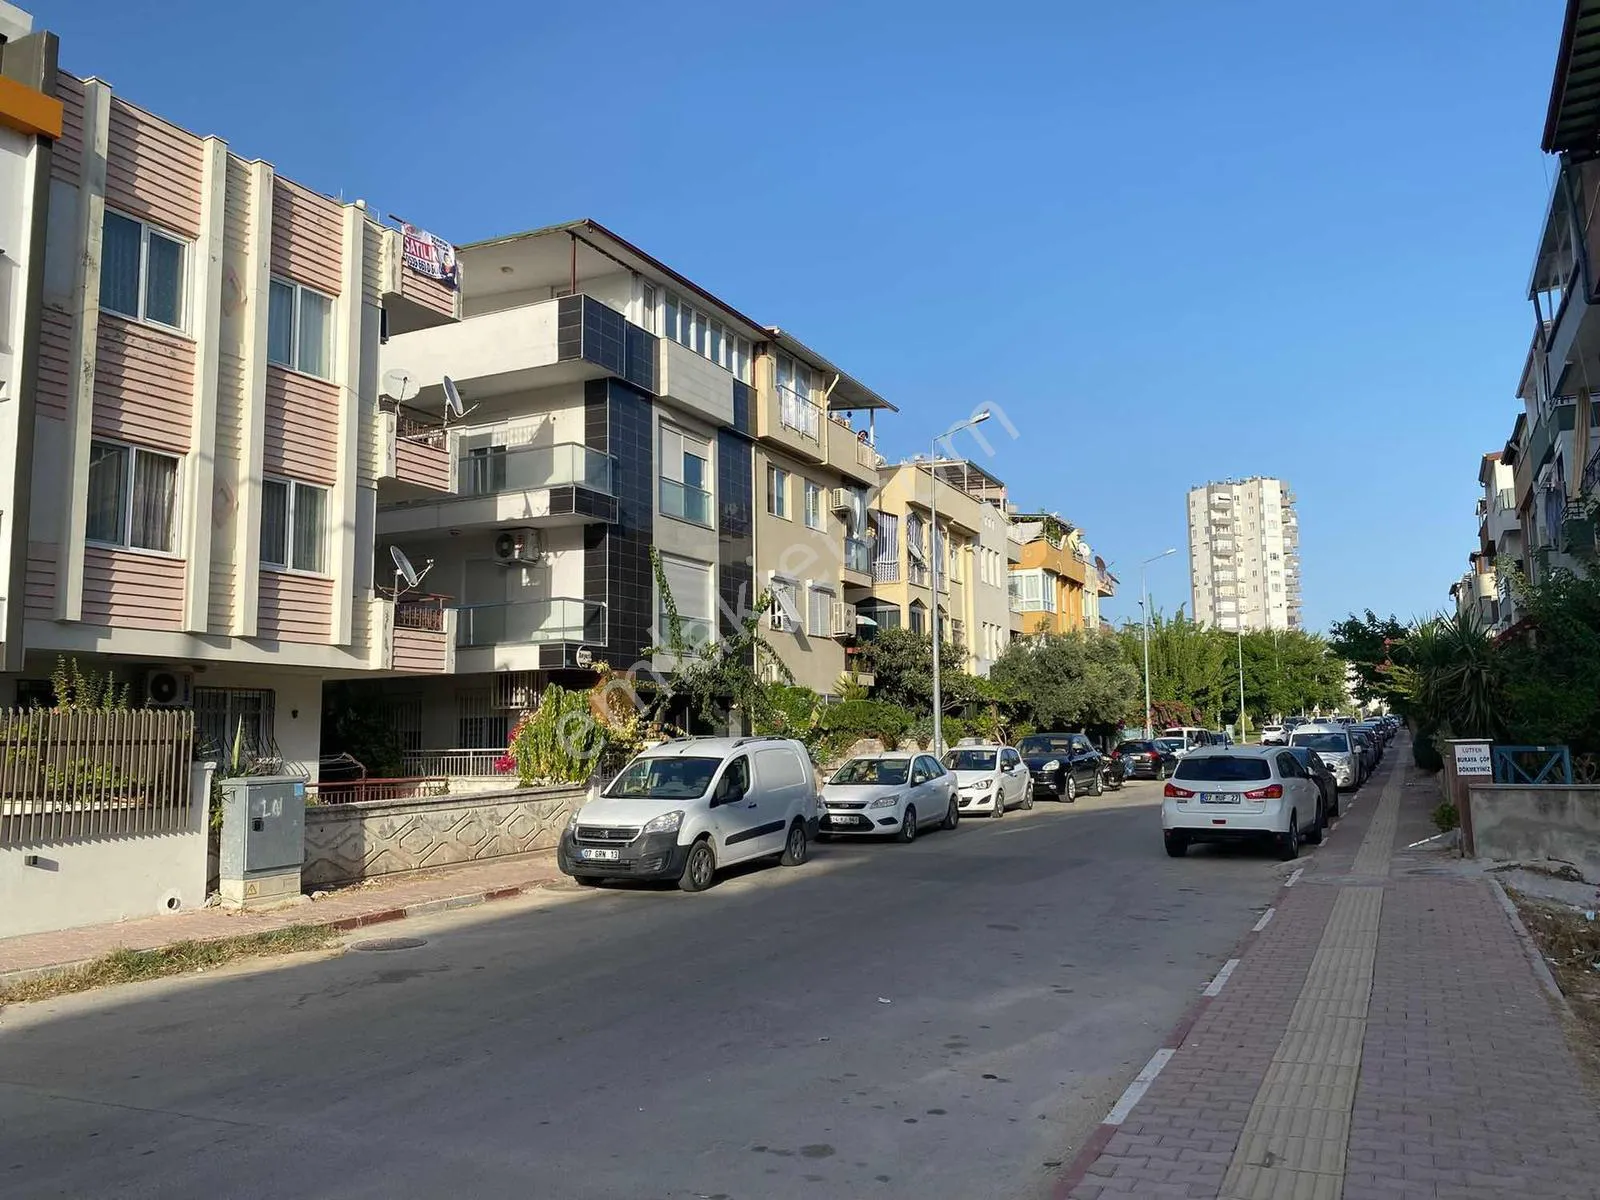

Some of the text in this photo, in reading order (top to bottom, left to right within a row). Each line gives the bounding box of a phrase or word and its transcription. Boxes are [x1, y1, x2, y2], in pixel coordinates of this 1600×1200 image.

[404, 236, 439, 262] SATILIK
[584, 849, 592, 858] 07
[611, 850, 618, 859] 13
